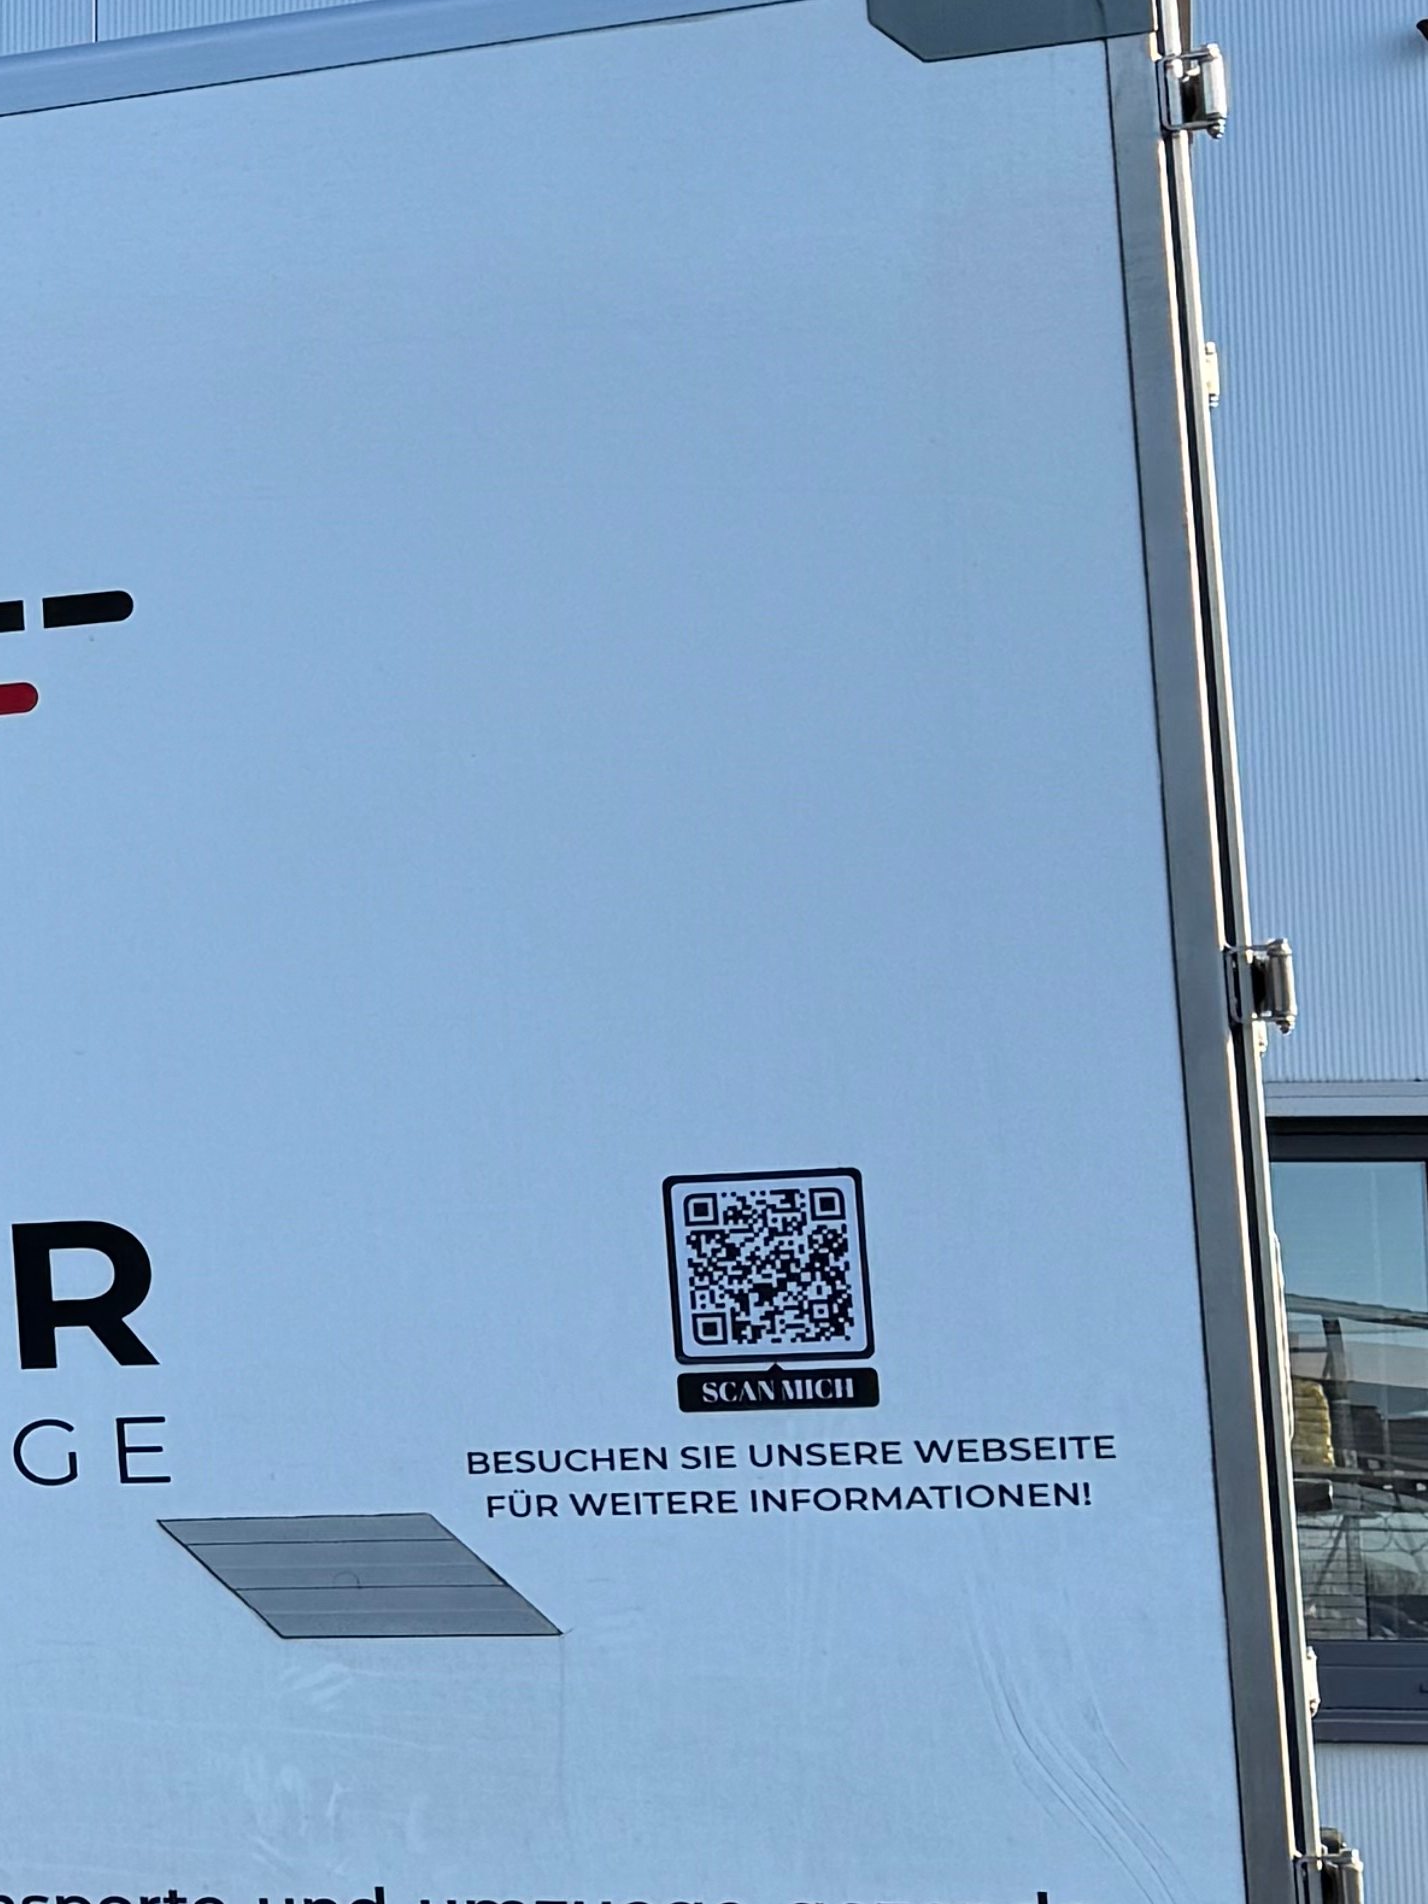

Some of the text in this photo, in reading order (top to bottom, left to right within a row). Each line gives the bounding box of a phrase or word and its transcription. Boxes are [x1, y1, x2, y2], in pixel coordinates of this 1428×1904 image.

[702, 1377, 854, 1403] SCAN MICH
[467, 1435, 1117, 1475] BESUCHEN SIE UNSERE WEBSEITE
[486, 1481, 1092, 1518] FÜR WEITERE INFORMATIONEN!
